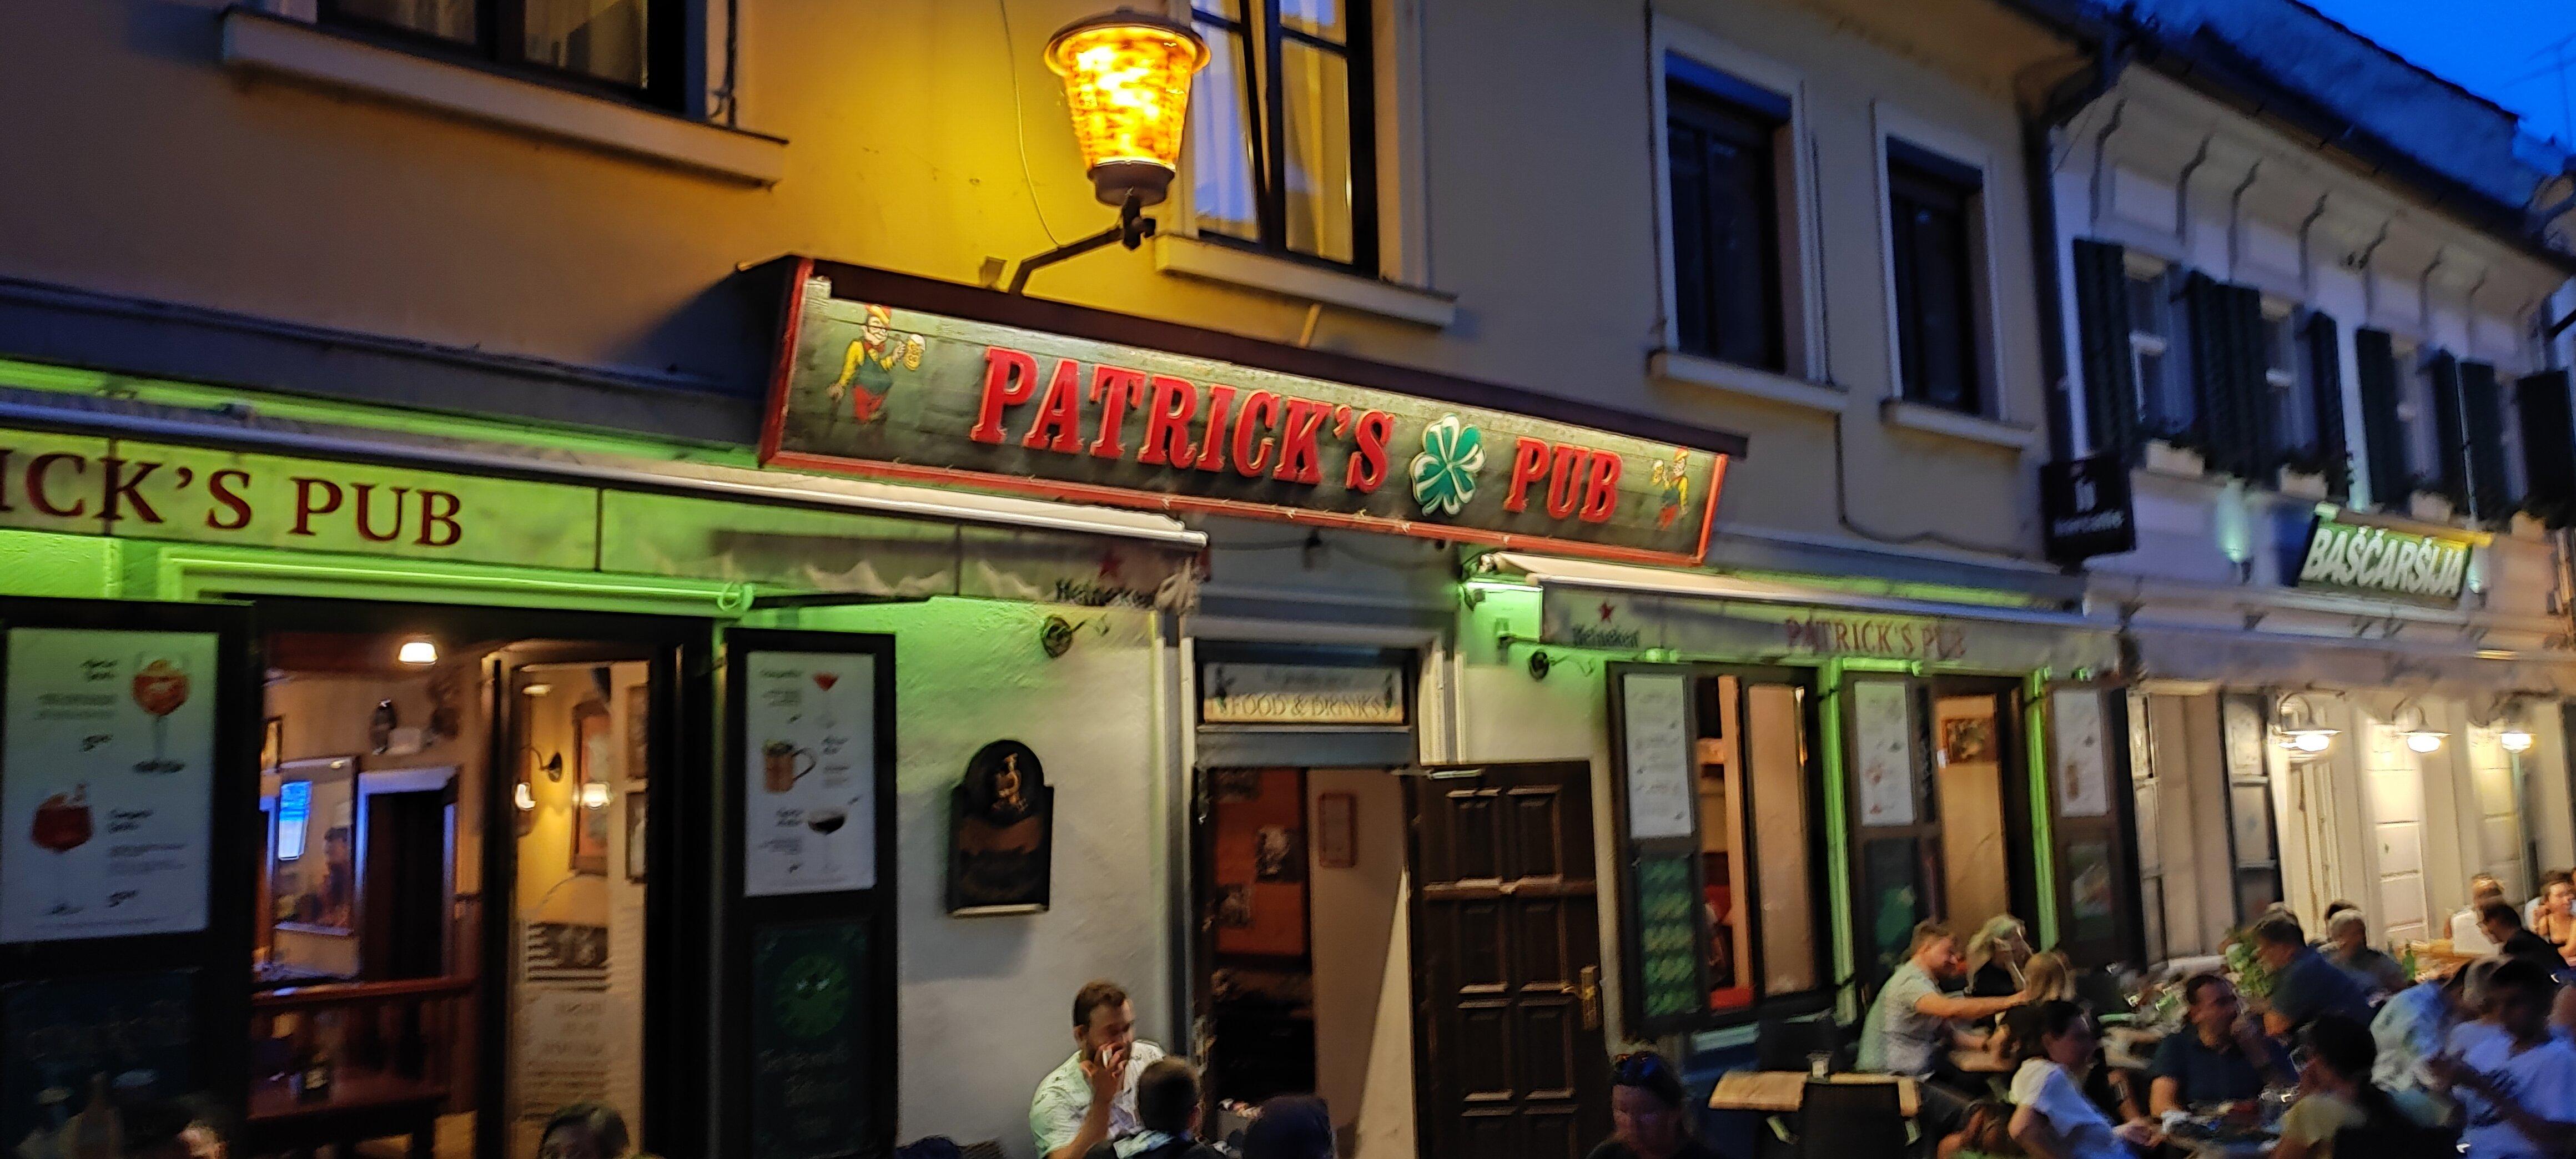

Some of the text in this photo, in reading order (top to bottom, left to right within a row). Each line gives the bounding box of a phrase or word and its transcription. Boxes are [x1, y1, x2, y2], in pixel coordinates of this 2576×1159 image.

[969, 345, 1623, 523] PATRICK'S PUB
[286, 476, 462, 547] PUB
[1785, 615, 1915, 656] PATRICK'S
[1231, 693, 1381, 718] FOOD & DRINKS
